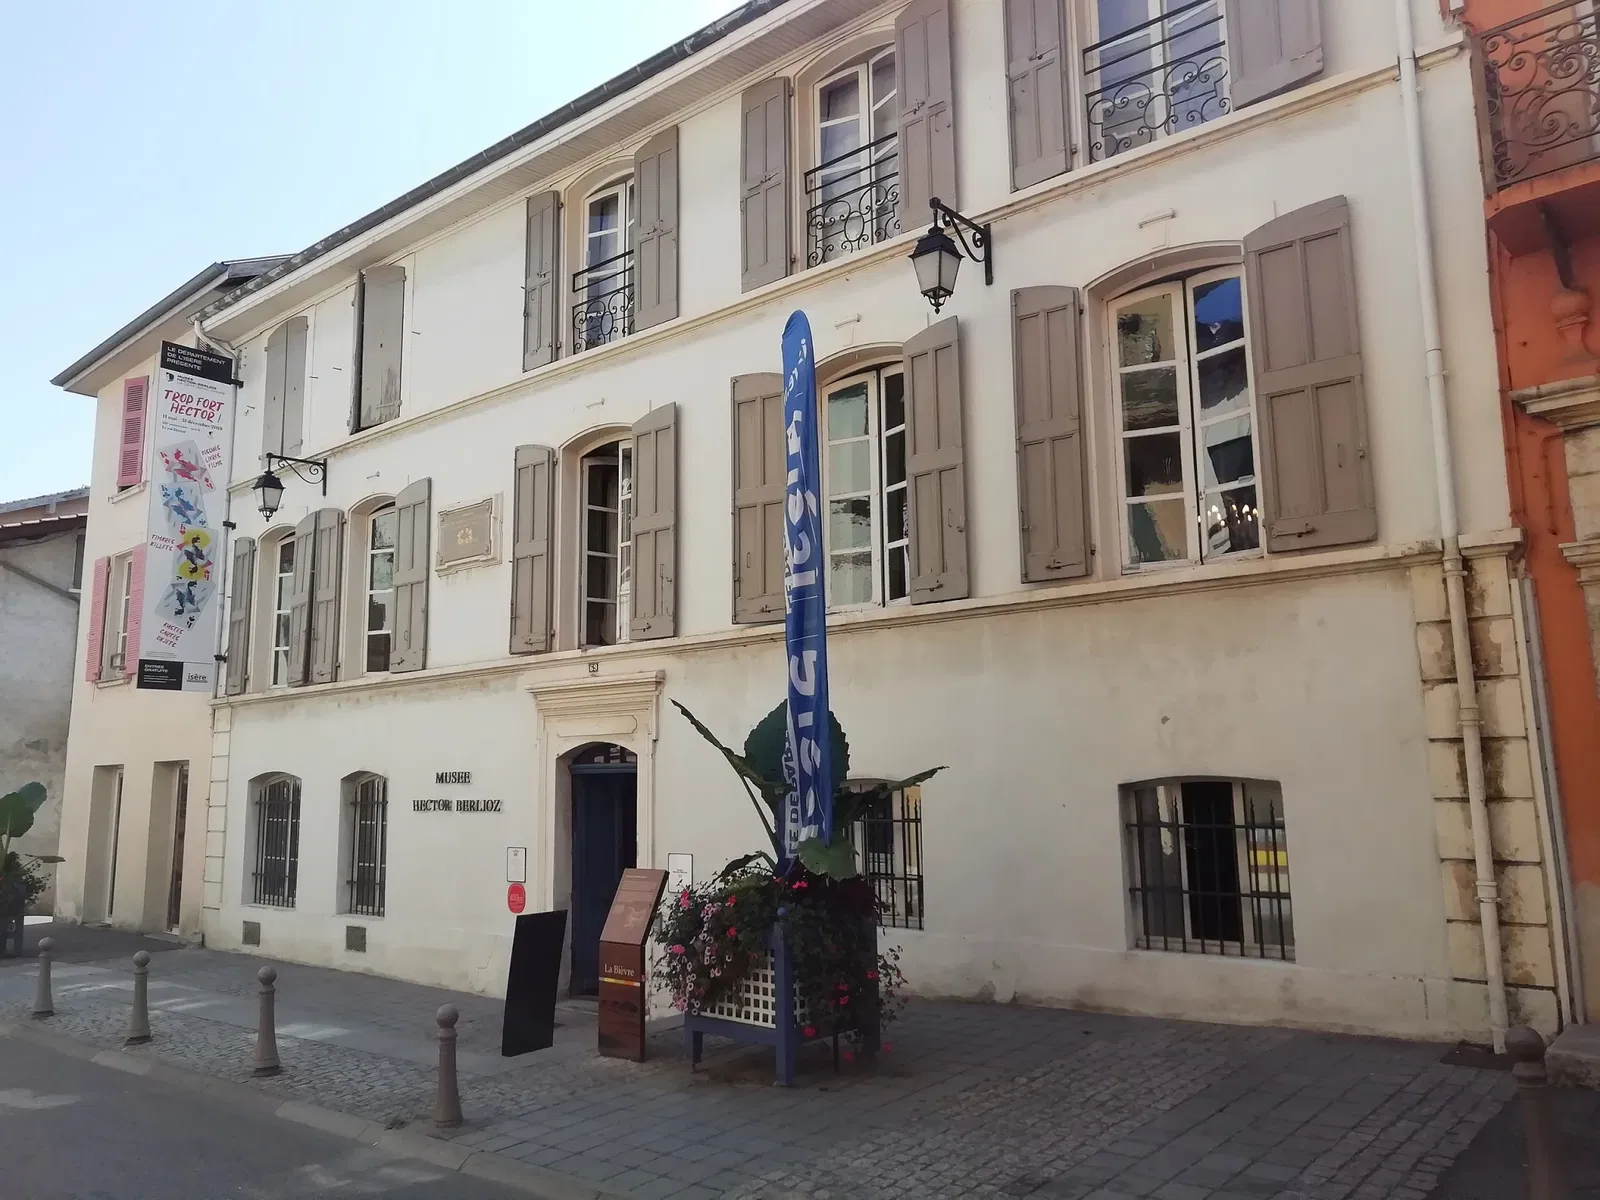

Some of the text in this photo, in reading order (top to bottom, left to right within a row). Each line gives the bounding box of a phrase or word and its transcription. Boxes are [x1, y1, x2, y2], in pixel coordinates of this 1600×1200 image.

[164, 389, 225, 412] TROP FORT
[170, 402, 215, 423] HECTOR
[187, 672, 207, 680] isère
[435, 771, 471, 784] MUSEE
[412, 799, 501, 812] HECTOR BERLIOZ
[604, 963, 635, 977] La Bièvre
